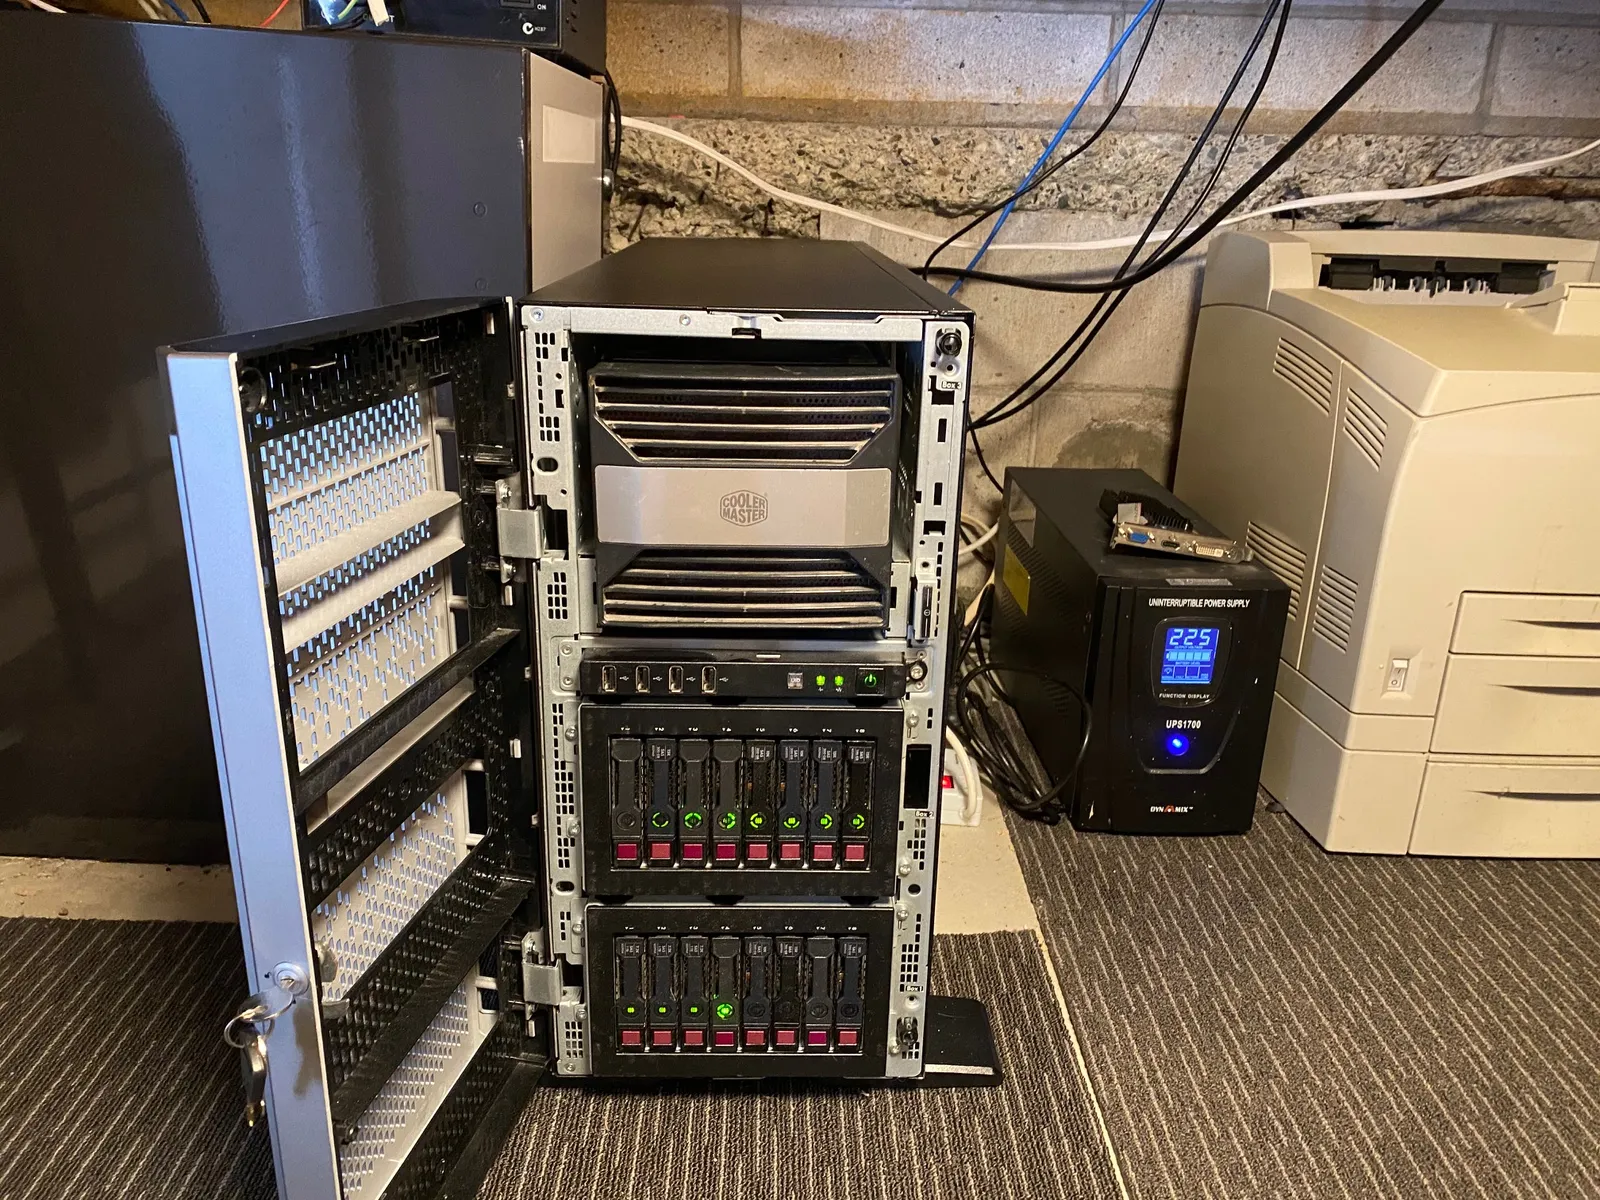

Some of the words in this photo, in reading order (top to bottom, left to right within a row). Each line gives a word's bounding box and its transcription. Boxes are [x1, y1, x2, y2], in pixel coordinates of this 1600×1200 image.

[722, 492, 766, 509] COOLER
[722, 508, 765, 524] MASTER
[1148, 598, 1203, 608] UNINTERRUPTIBLE
[1204, 599, 1226, 608] POWER
[1226, 599, 1250, 608] SUPPLY
[1169, 628, 1211, 645] 225
[1166, 720, 1201, 729] UPS1700
